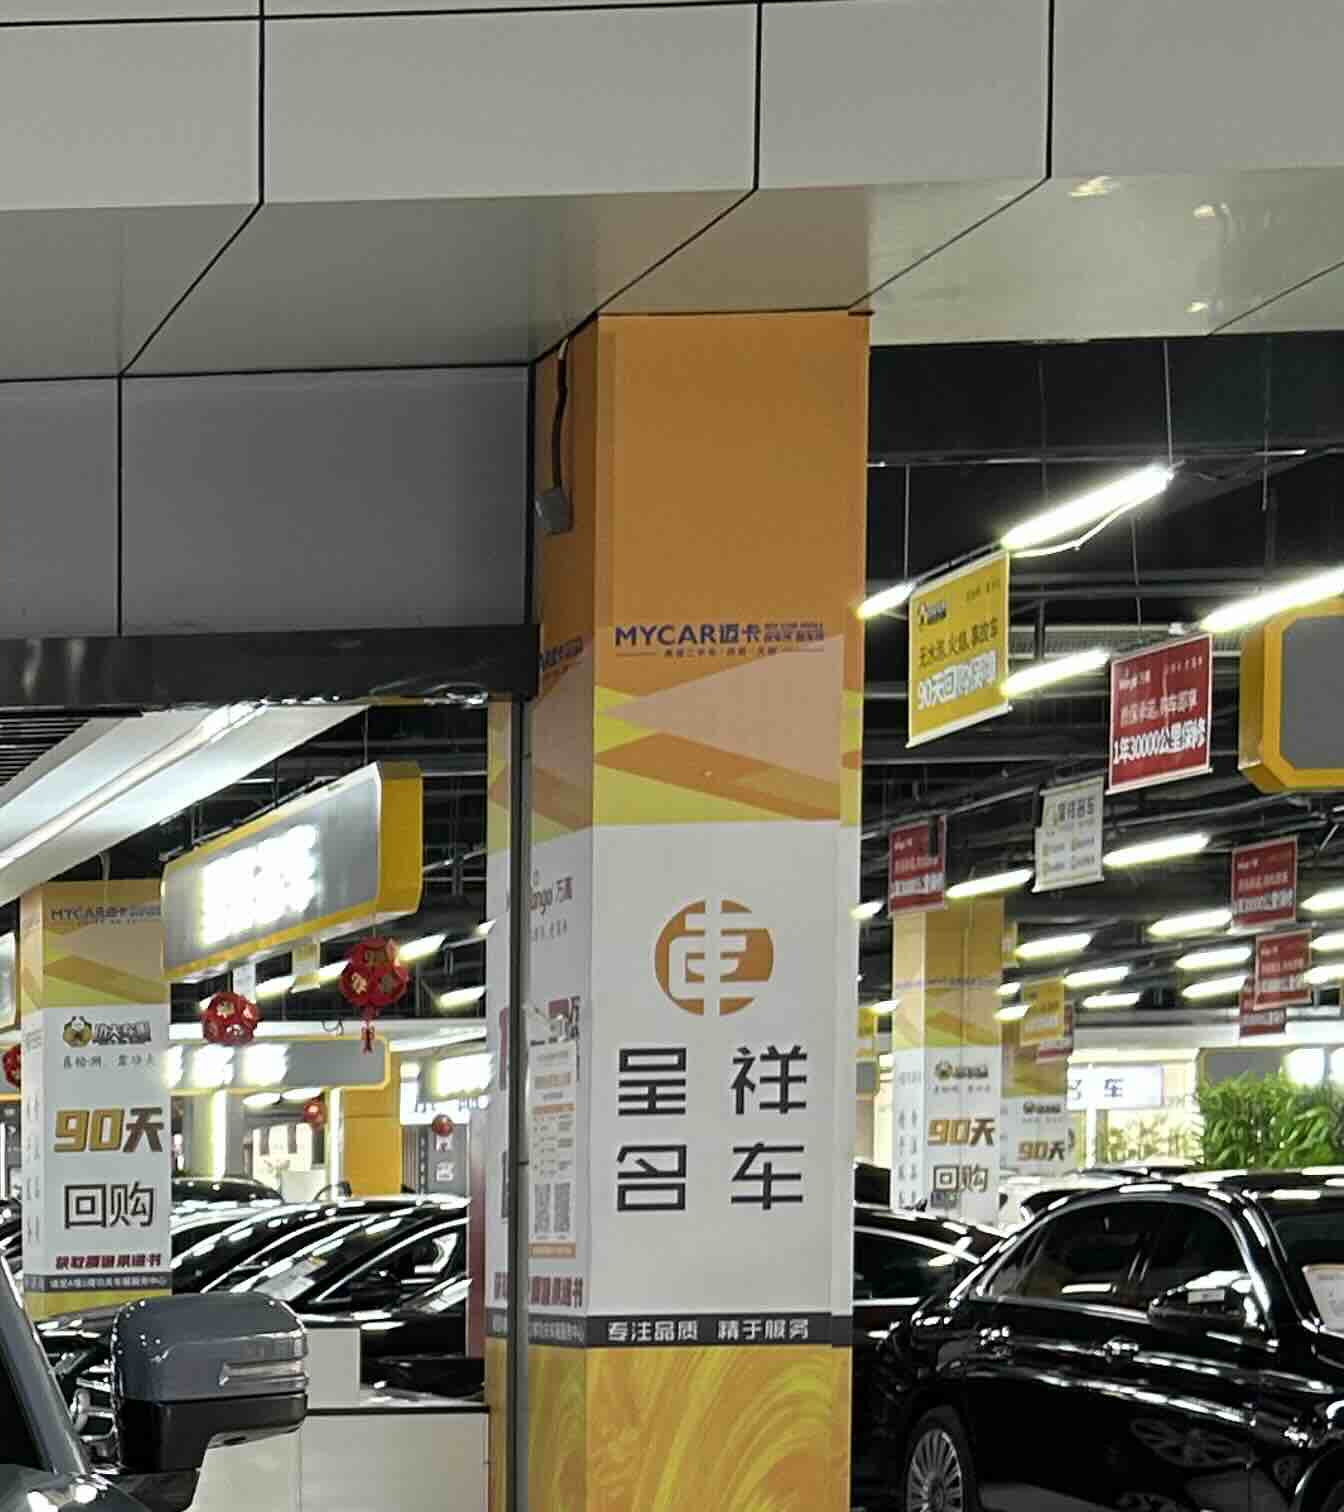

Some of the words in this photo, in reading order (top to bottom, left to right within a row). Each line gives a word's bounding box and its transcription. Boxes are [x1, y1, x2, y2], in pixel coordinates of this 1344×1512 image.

[617, 1044, 809, 1118] 呈祥
[54, 1107, 165, 1153] 90天
[927, 1119, 996, 1146] 90天
[616, 1142, 805, 1213] 名车
[933, 1165, 989, 1193] 回购
[64, 1182, 155, 1230] 回购
[608, 1320, 699, 1342] 专注品质
[717, 1318, 809, 1341] 精于服务
